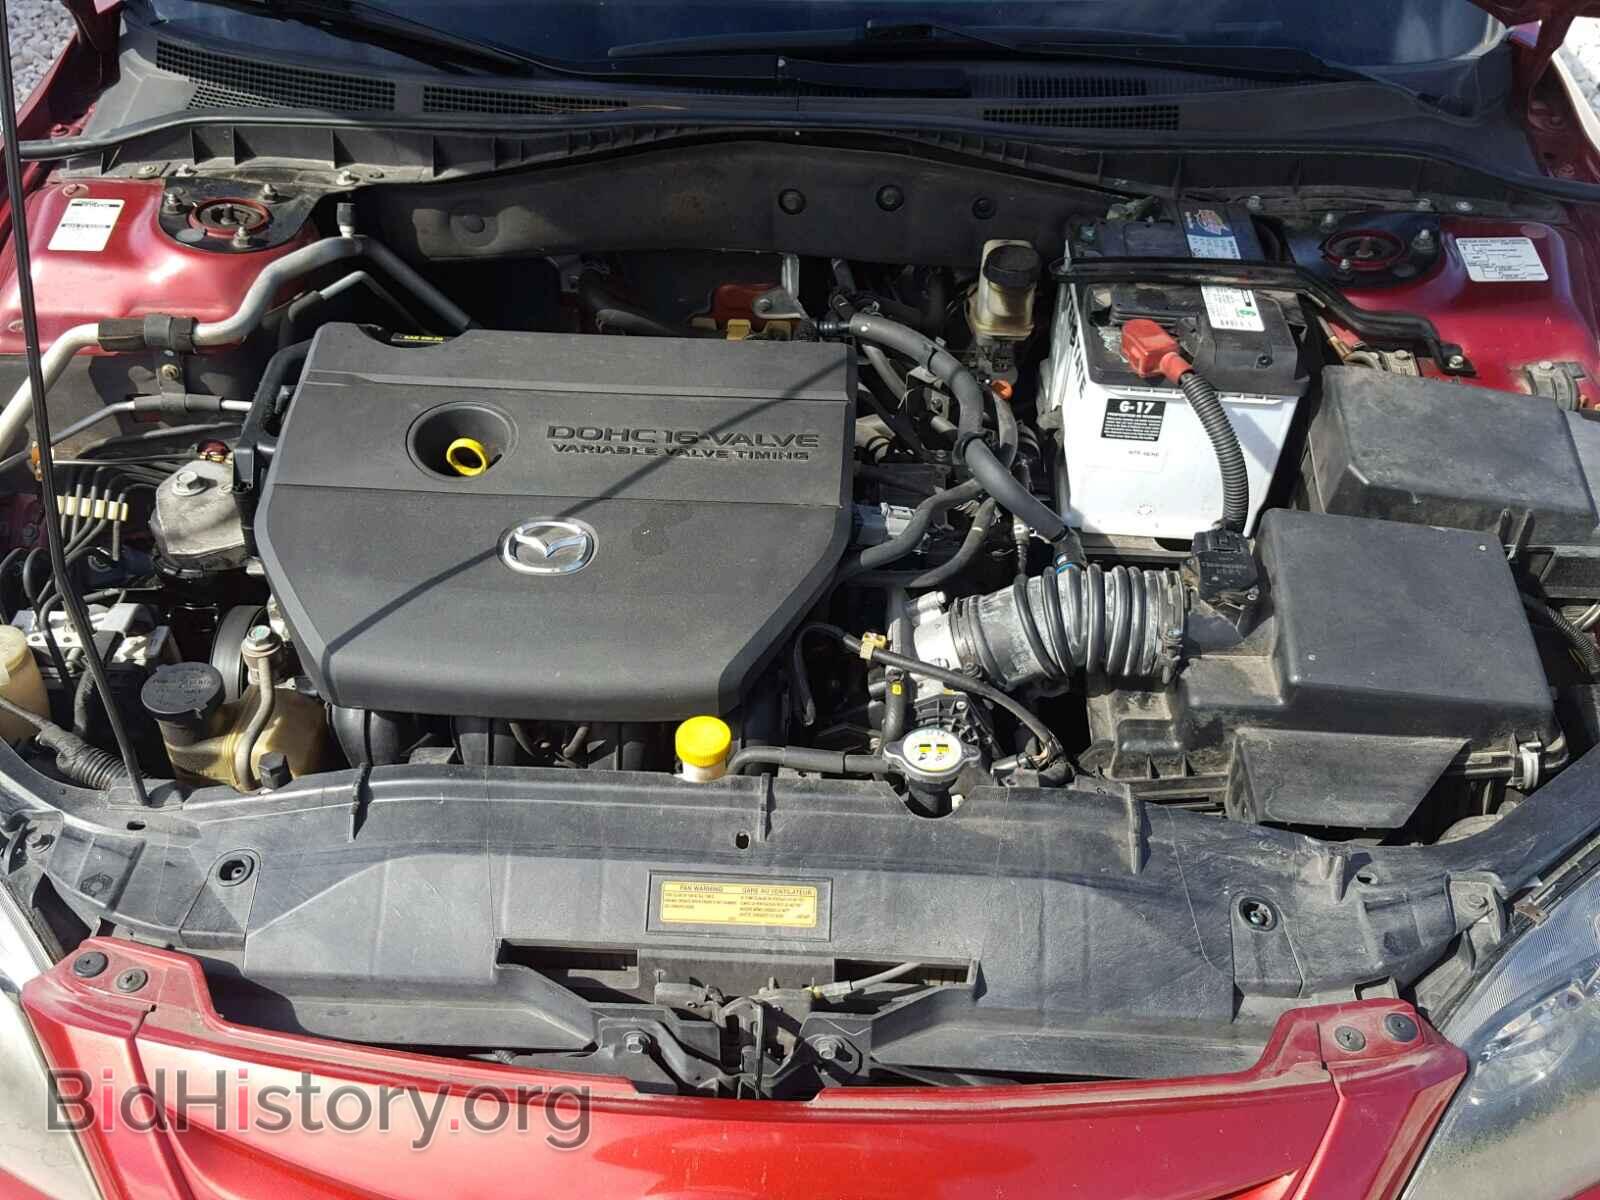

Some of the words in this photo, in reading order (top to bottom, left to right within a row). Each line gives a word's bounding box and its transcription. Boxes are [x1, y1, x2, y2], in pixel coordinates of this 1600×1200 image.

[546, 425, 657, 444] DOHC
[663, 429, 819, 448] 16-VALVE
[551, 444, 658, 456] VARIABLE
[664, 447, 729, 459] VALVE
[735, 450, 809, 461] TIMING
[693, 884, 724, 893] WARNING
